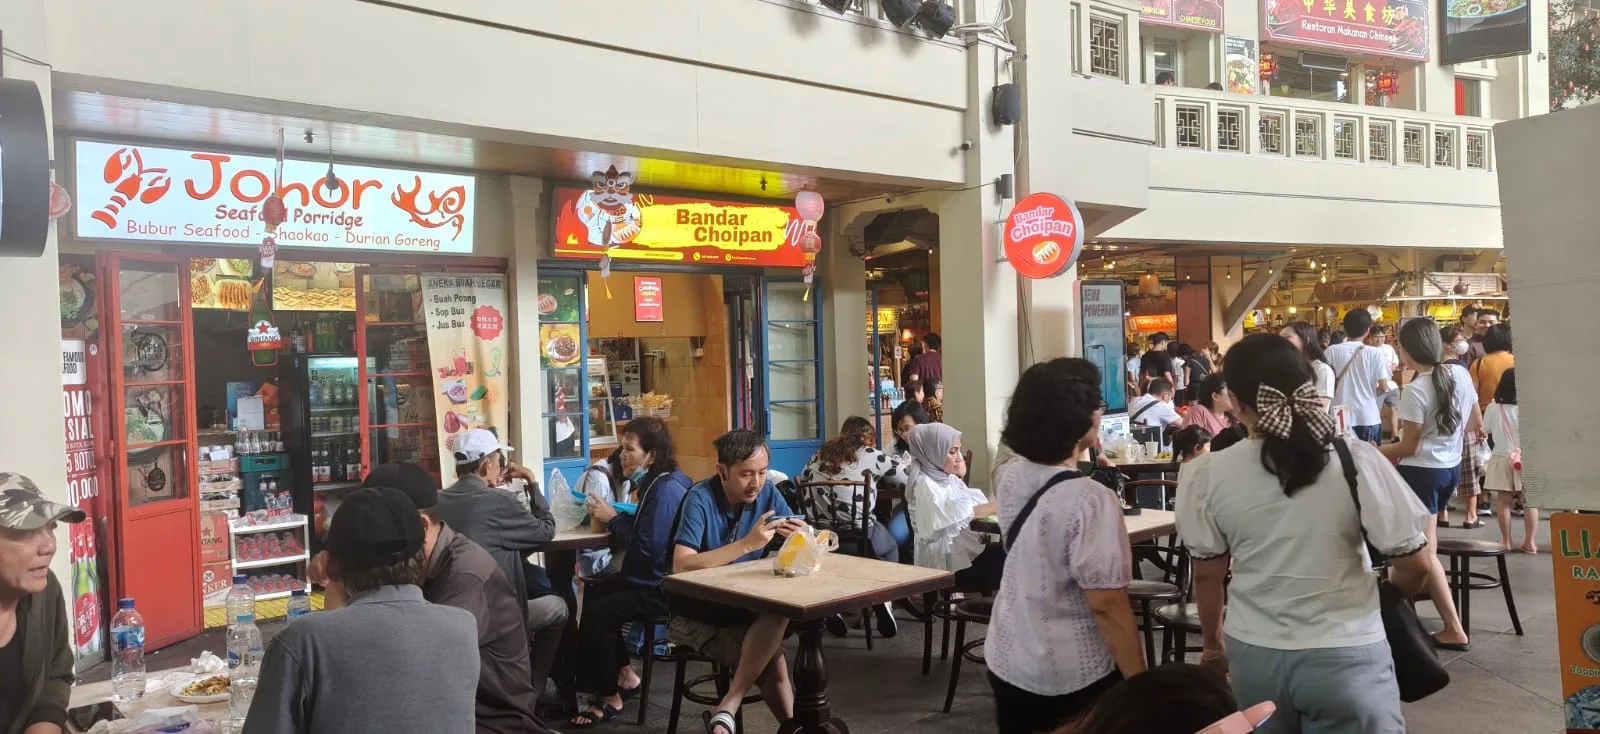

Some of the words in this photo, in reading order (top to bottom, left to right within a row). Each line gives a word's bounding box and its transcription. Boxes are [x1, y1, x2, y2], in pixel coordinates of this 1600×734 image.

[1200, 17, 1216, 26] FOOD
[1302, 20, 1336, 34] Restoran
[1338, 25, 1368, 38] Makanan
[184, 153, 383, 210] Johor
[215, 204, 288, 222] Seafo
[294, 208, 363, 230] Porridge
[677, 209, 748, 226] Bandar
[1014, 206, 1055, 224] Bandar
[127, 219, 177, 235] Bubur
[184, 223, 250, 239] Seafood
[346, 231, 390, 245] Durian
[394, 233, 441, 250] Goreng
[694, 226, 773, 246] Choipan
[1011, 218, 1072, 242] Choipan
[435, 308, 449, 318] Sop
[437, 320, 449, 329] Jus
[250, 335, 280, 343] BINTANG
[62, 363, 78, 374] FOOD
[65, 417, 94, 441] SIAL
[1337, 409, 1345, 433] 1
